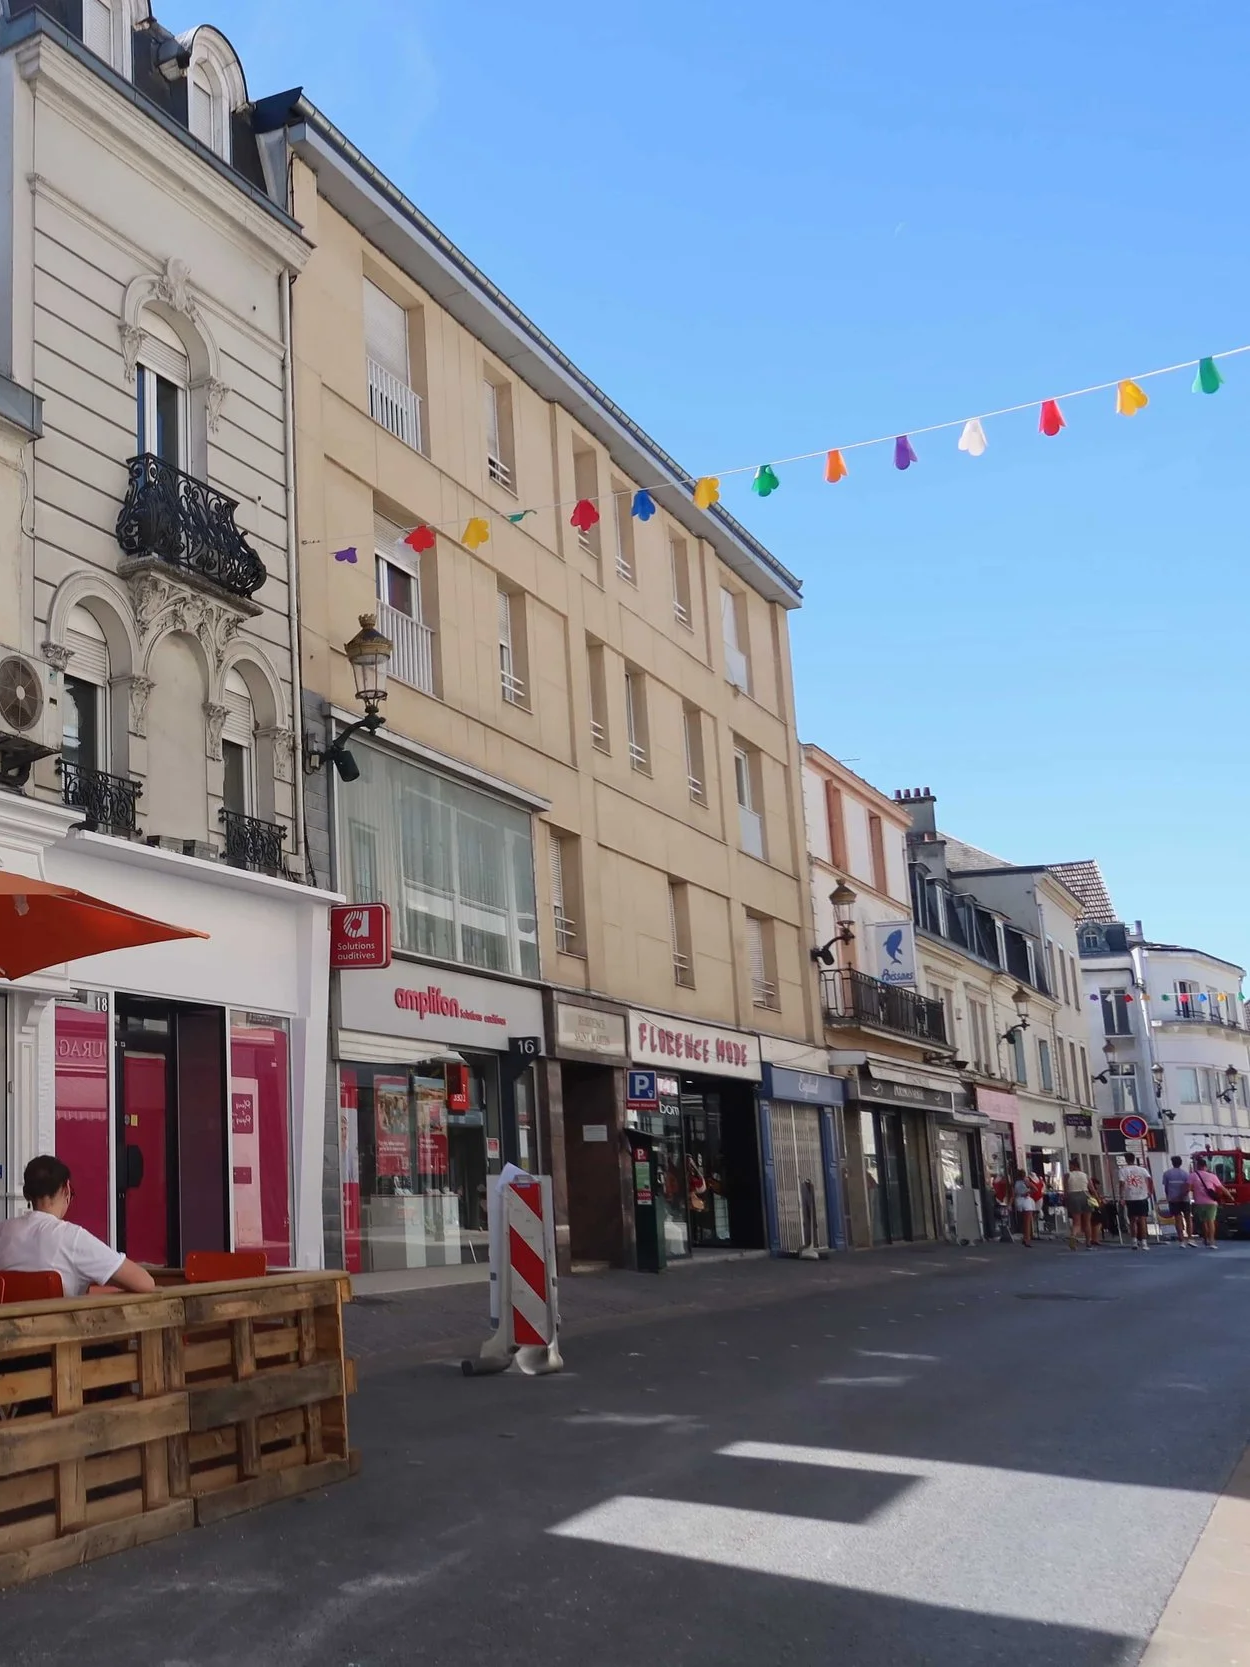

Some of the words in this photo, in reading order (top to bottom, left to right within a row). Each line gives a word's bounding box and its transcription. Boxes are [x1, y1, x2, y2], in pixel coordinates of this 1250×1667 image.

[337, 942, 375, 951] Solutions
[337, 951, 376, 961] auditives
[881, 968, 914, 981] Poissons
[96, 997, 108, 1012] 18
[394, 986, 459, 1020] amplifon
[517, 1039, 535, 1054] 16
[638, 1022, 710, 1064] FLORENCE
[715, 1037, 748, 1067] MODE
[634, 1074, 650, 1096] P
